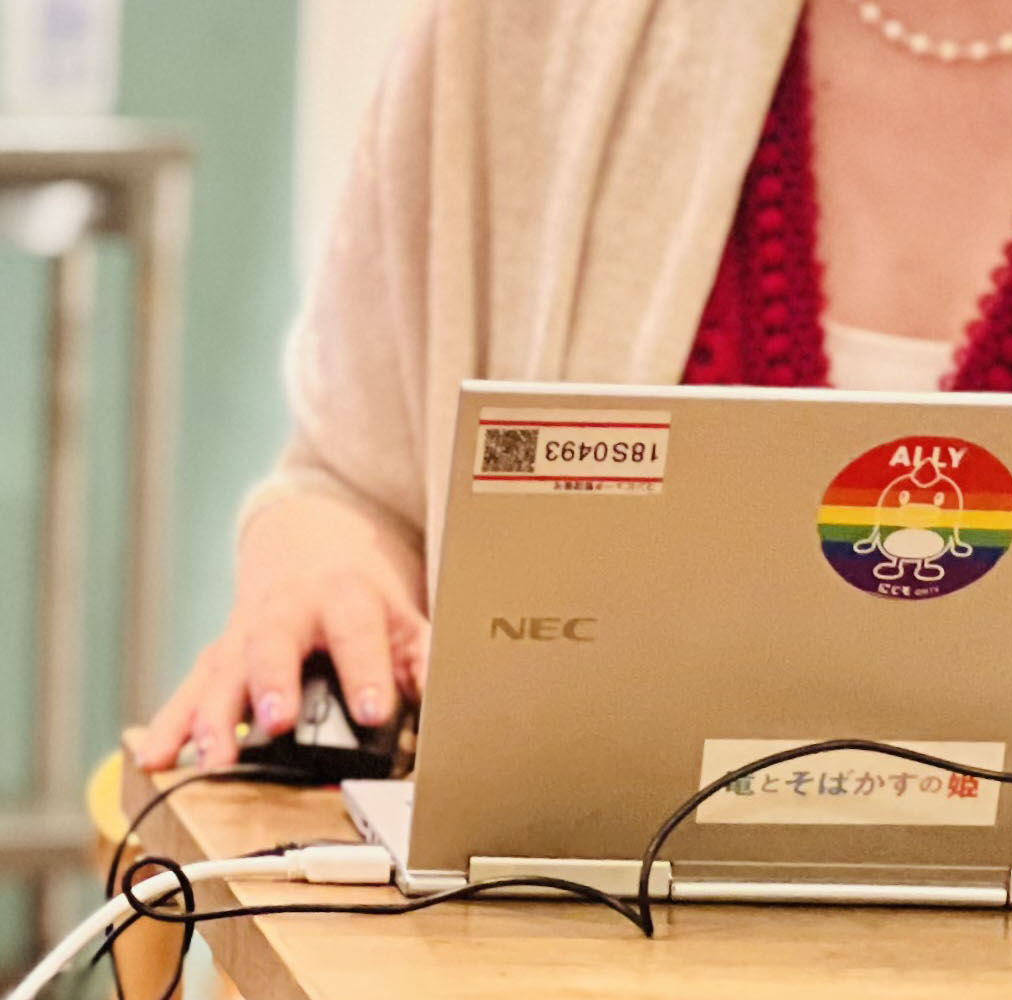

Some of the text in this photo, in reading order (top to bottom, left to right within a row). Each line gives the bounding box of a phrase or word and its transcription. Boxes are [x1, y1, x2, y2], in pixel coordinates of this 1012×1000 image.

[545, 441, 659, 463] 18S0493
[889, 446, 968, 468] ALLY
[491, 617, 599, 641] NEC
